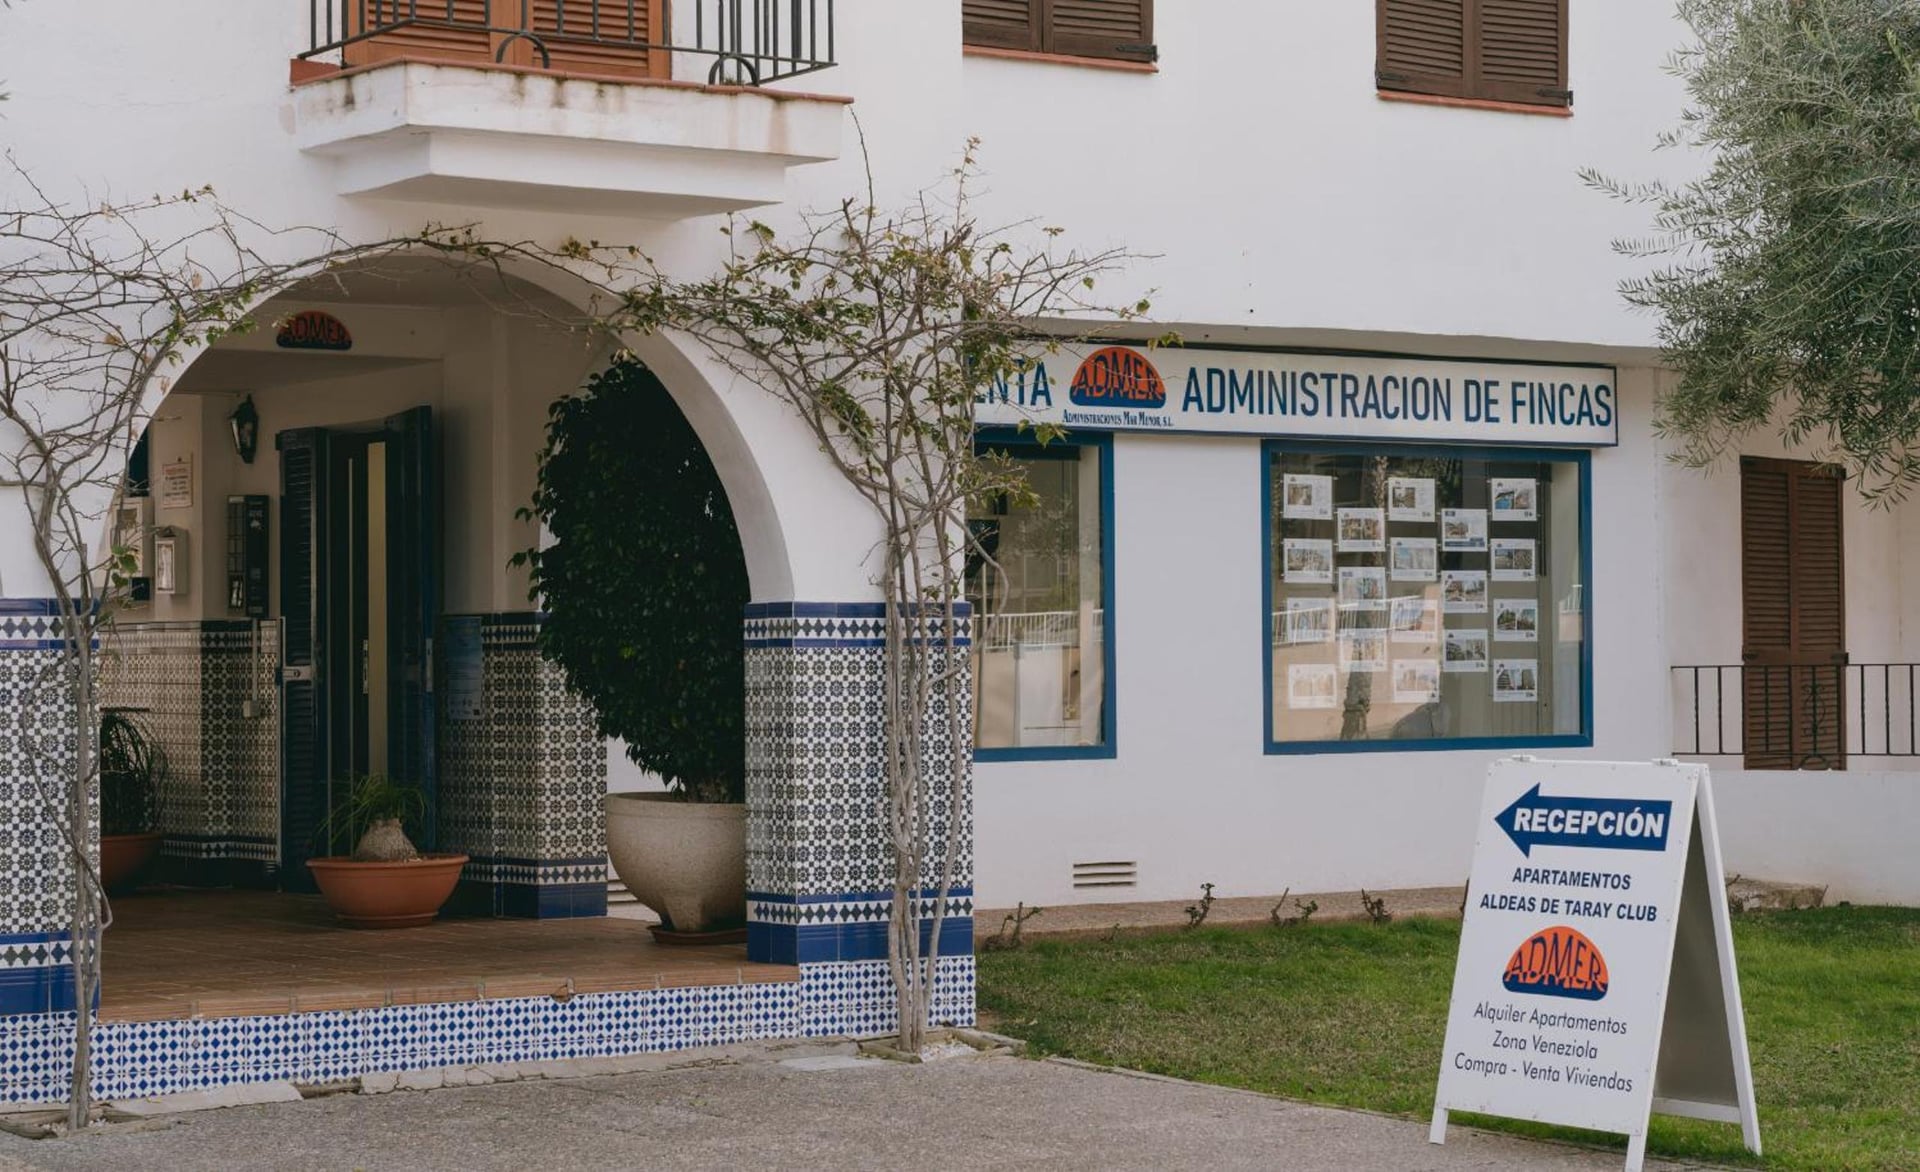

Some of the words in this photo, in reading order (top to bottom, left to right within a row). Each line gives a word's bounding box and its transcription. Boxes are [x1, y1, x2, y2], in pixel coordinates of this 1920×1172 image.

[1072, 351, 1163, 400] ADMER
[1181, 366, 1452, 422] ADMINISTRACION
[1464, 379, 1501, 424] DE
[1511, 381, 1612, 427] FINCAS
[1513, 806, 1665, 838] RECEPCIÓN
[1512, 867, 1632, 891] APARTAMENTOS
[1480, 893, 1536, 913] ALDEAS
[1540, 898, 1560, 915] DE
[1565, 899, 1613, 920] TARAY
[1616, 904, 1658, 922] CLUB
[1504, 932, 1607, 993] ADMER
[1473, 1002, 1527, 1024] Alquiler
[1529, 1008, 1628, 1035] Apartamentos
[1492, 1030, 1527, 1051] Zona
[1532, 1034, 1599, 1059] Veneziola
[1454, 1052, 1508, 1078] Compra
[1522, 1060, 1560, 1083] Venta
[1566, 1066, 1633, 1092] Viviendas
